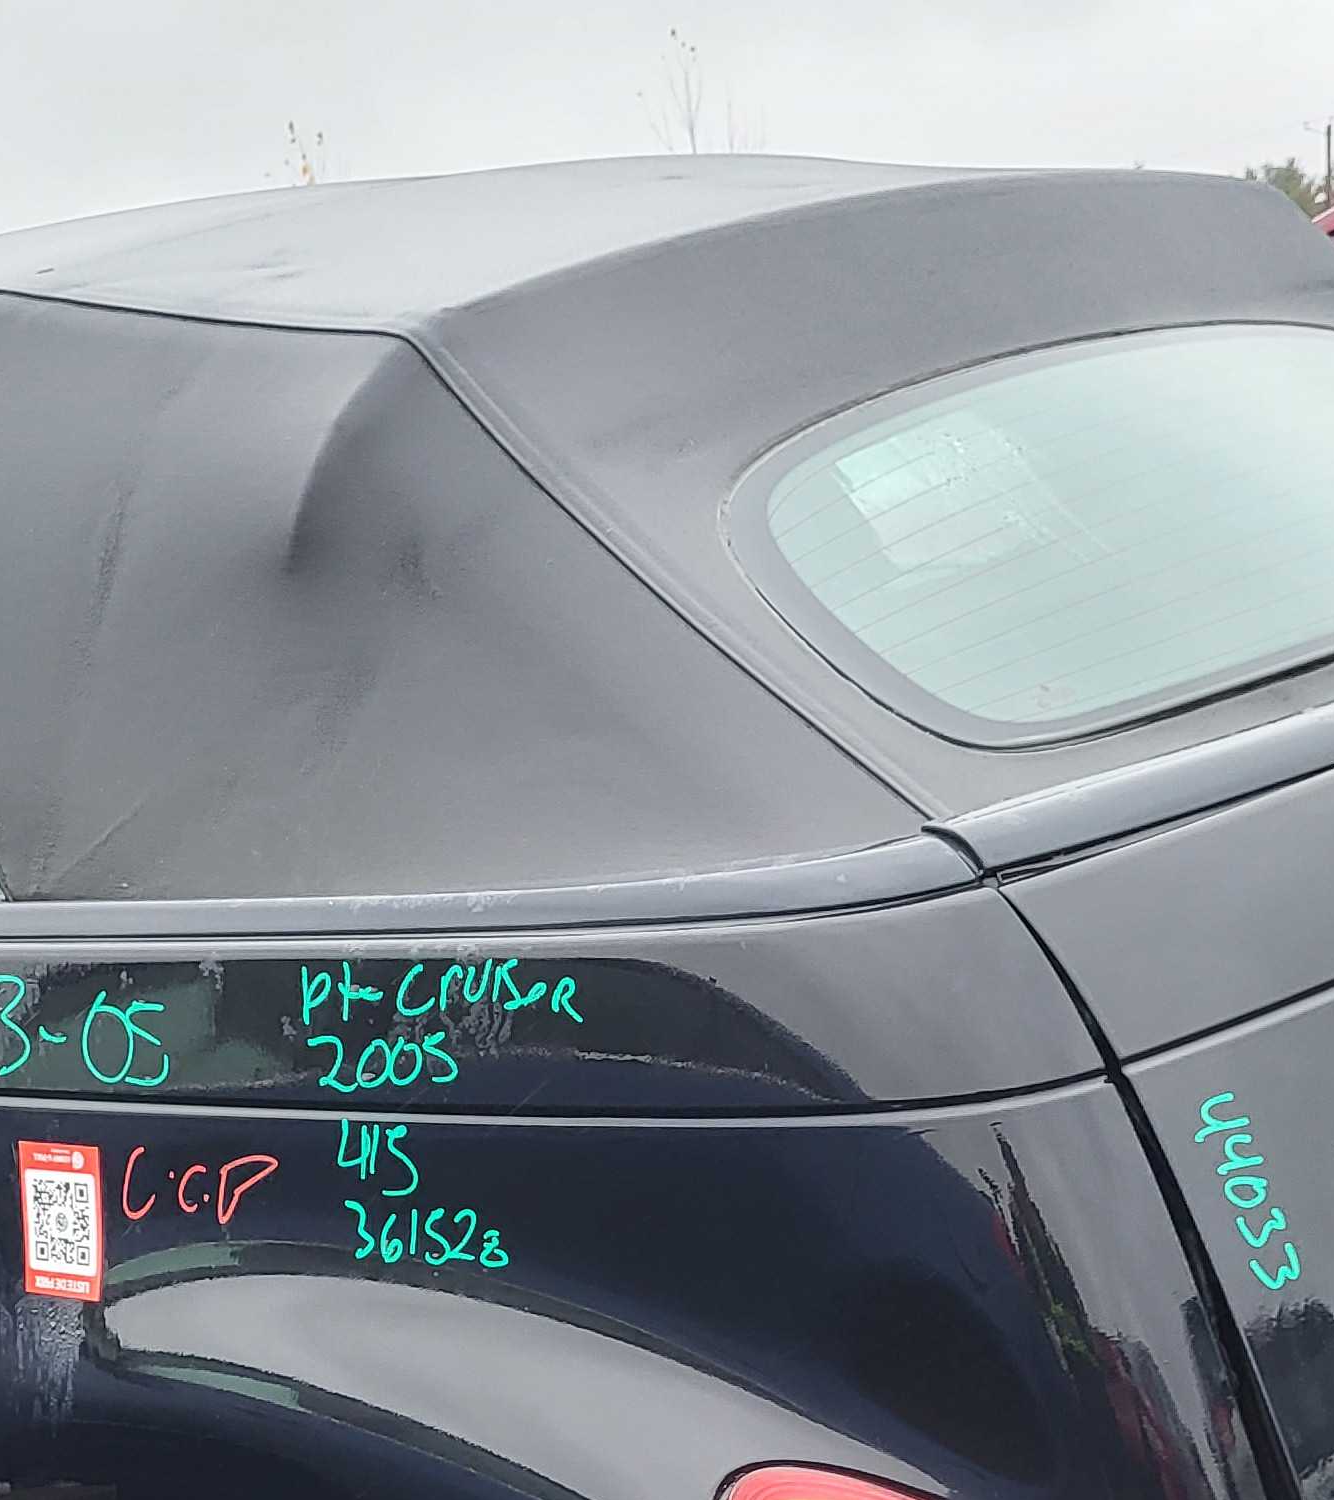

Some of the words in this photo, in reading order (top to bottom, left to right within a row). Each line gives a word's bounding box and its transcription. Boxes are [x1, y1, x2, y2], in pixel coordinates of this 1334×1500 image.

[307, 1031, 459, 1093] 2005
[337, 1118, 419, 1197] 415
[1194, 1090, 1301, 1291] 44033
